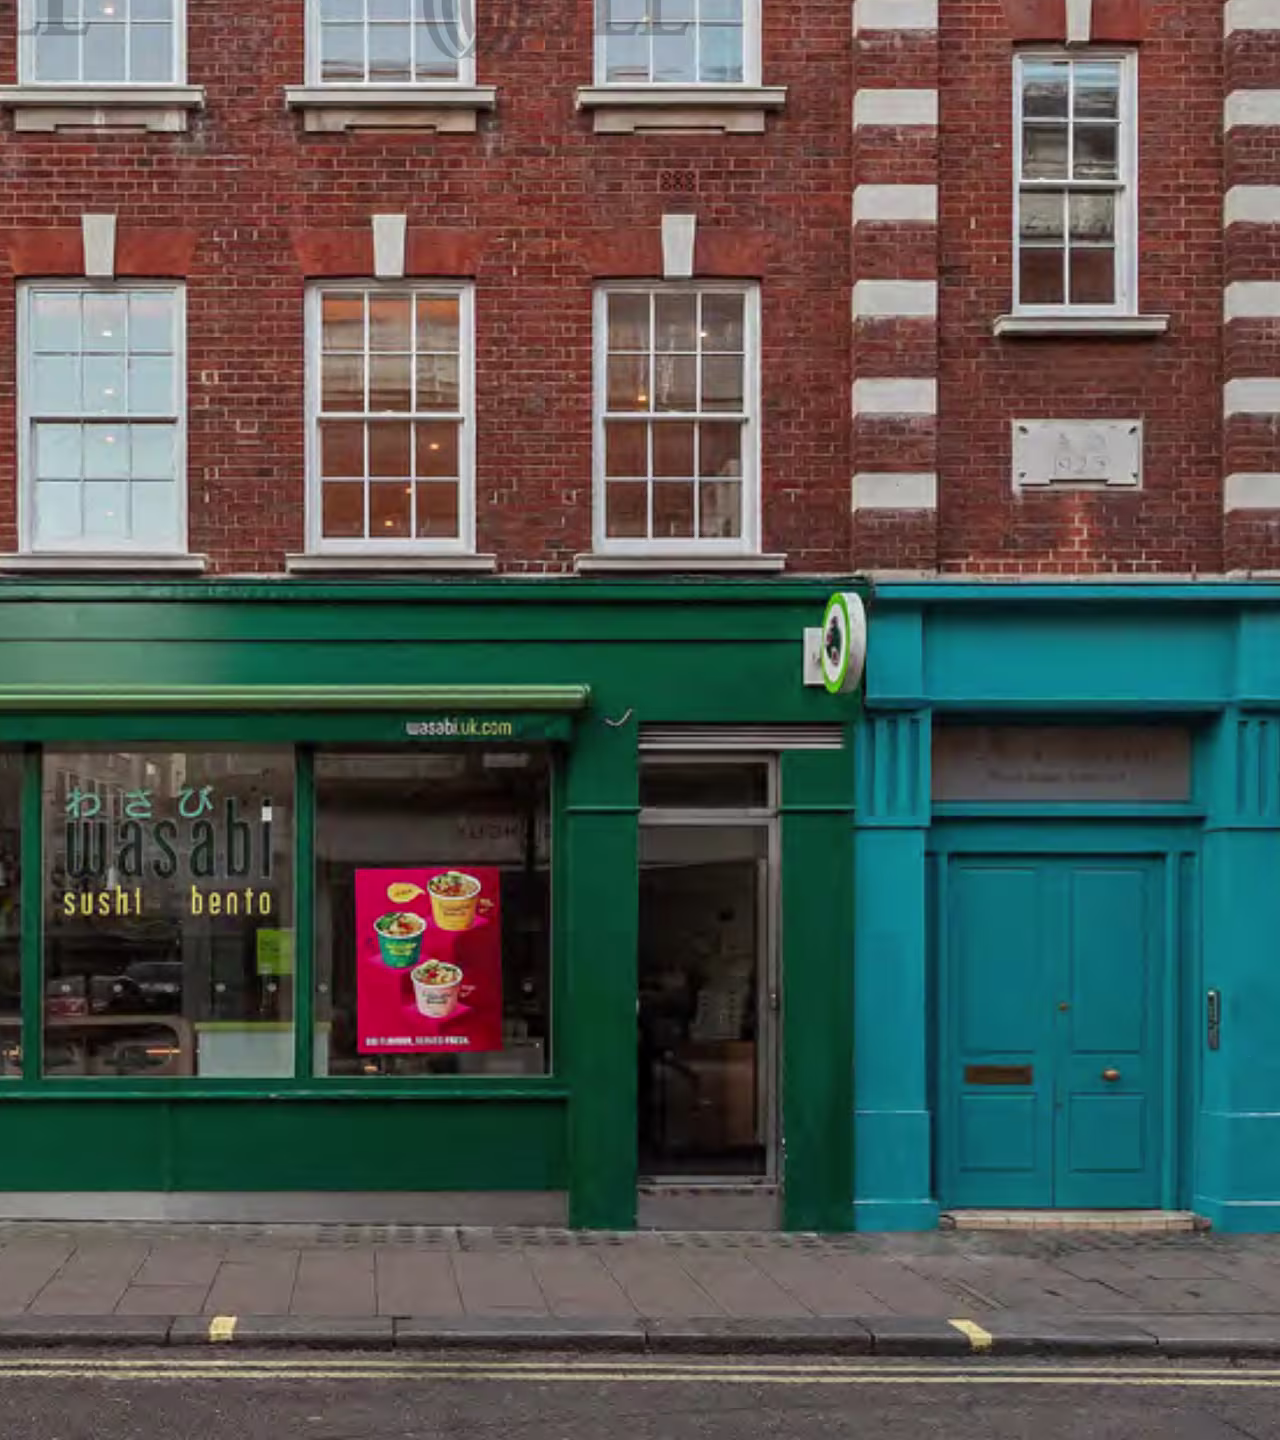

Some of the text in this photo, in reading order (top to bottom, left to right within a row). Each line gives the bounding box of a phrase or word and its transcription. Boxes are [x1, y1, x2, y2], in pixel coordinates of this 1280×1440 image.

[66, 786, 213, 818] わさび
[65, 797, 273, 879] wasabi
[64, 884, 272, 916] sushi bento
